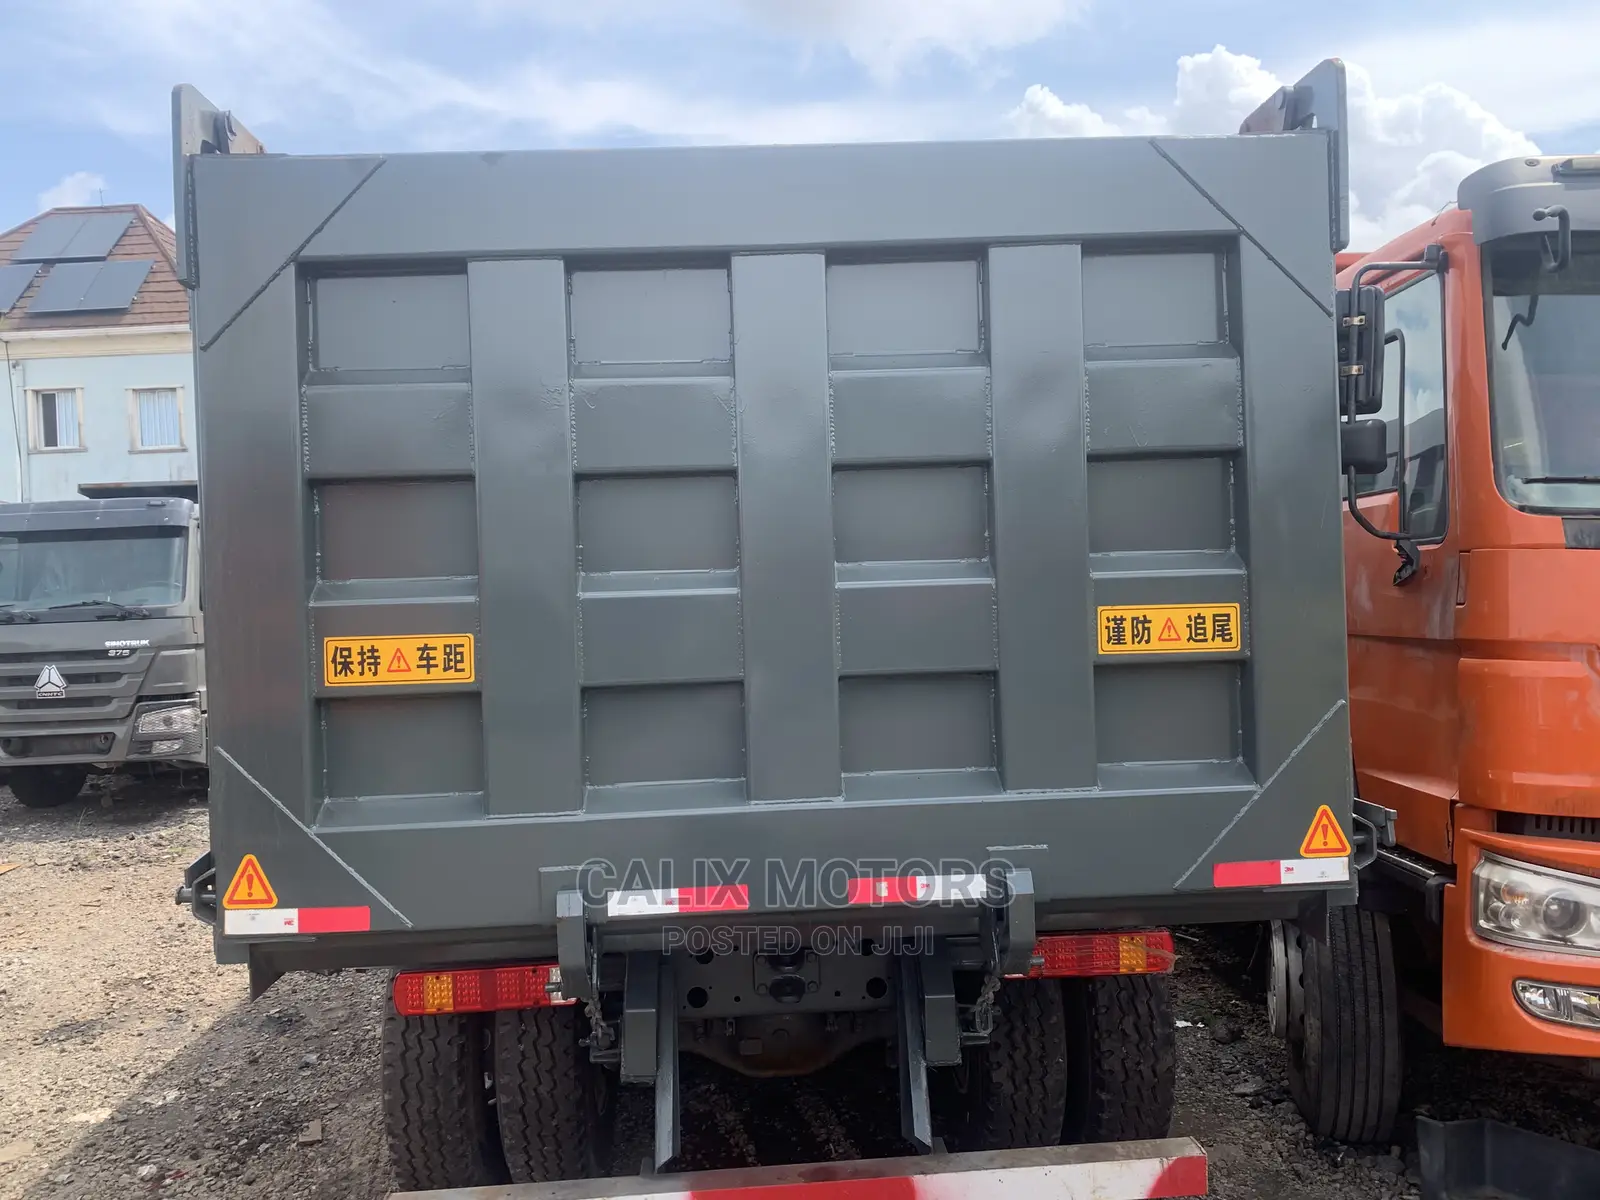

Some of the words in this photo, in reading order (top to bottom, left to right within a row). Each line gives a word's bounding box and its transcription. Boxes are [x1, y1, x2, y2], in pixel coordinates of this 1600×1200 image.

[104, 639, 150, 648] SINOTRUK
[1105, 614, 1152, 645] 谨防
[1186, 613, 1233, 643] 追尾
[331, 645, 380, 677] 保持
[416, 643, 465, 674] 车距
